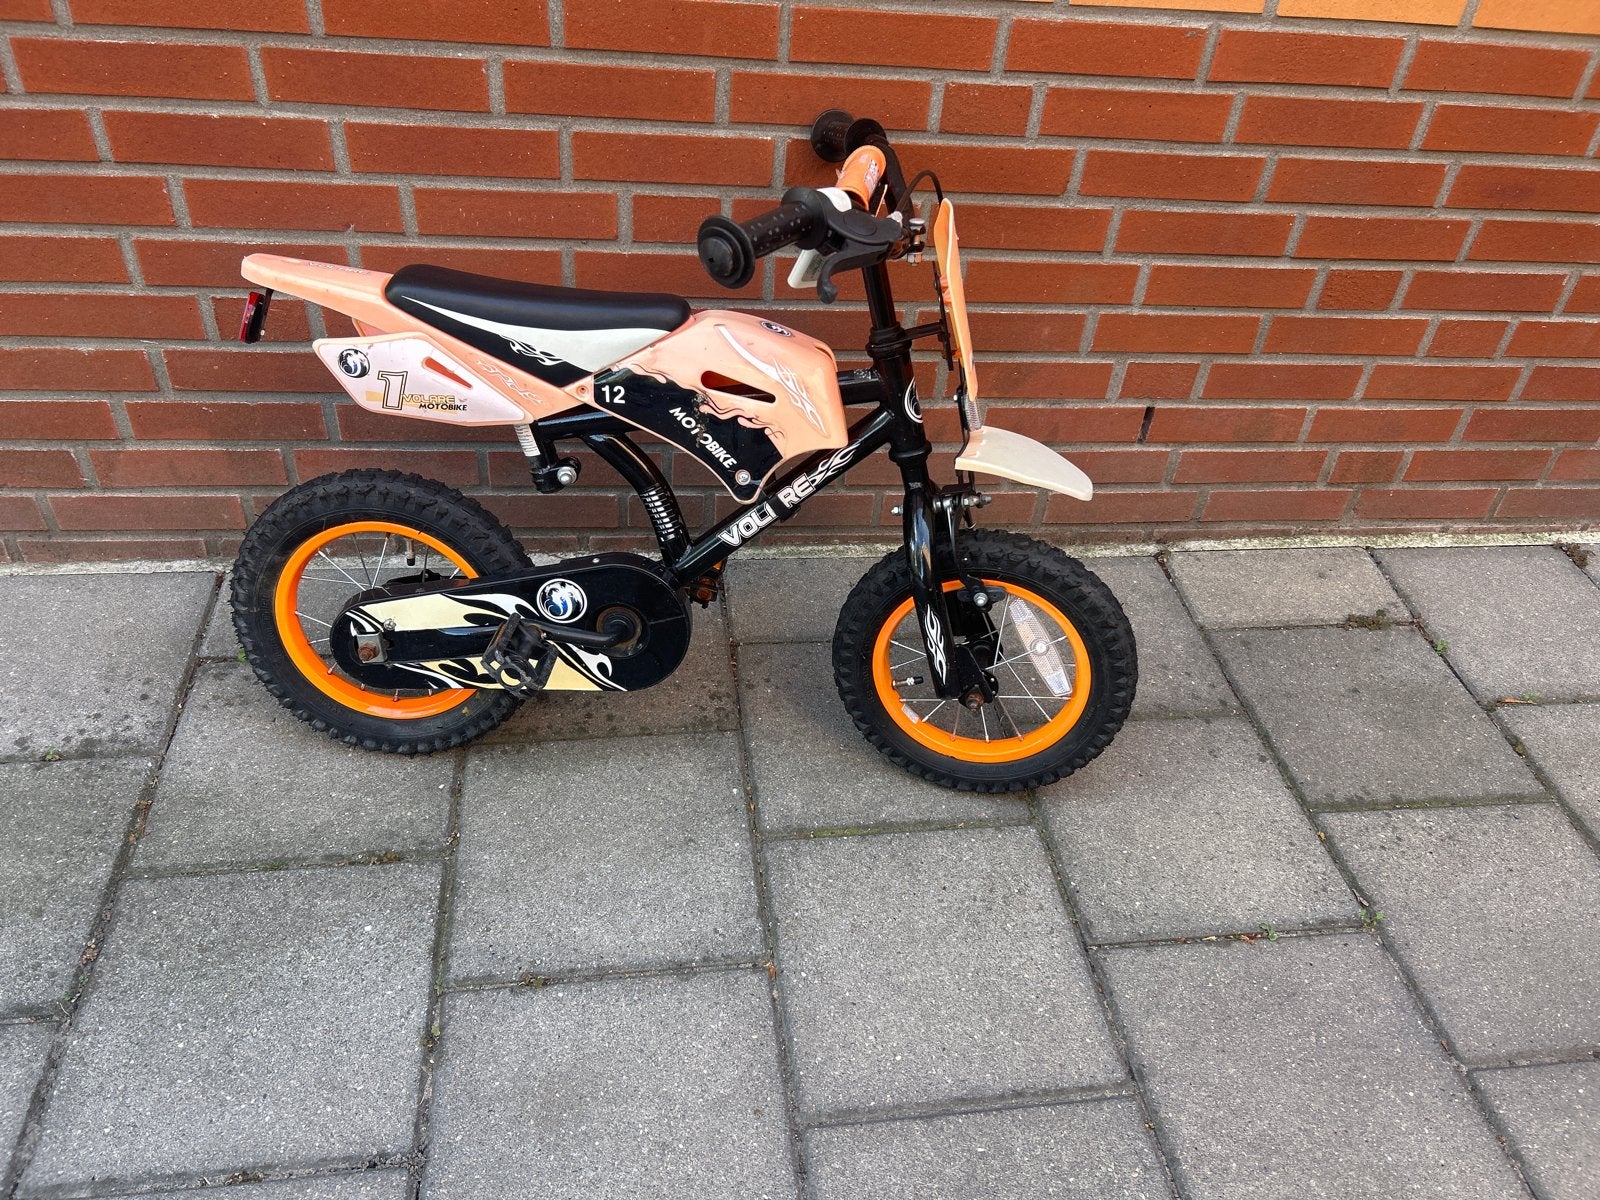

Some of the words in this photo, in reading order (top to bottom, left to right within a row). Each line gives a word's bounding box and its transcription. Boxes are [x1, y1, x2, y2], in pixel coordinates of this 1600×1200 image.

[402, 394, 455, 404] VOLARE
[601, 384, 626, 405] 12
[419, 403, 468, 411] MOTOBIKE
